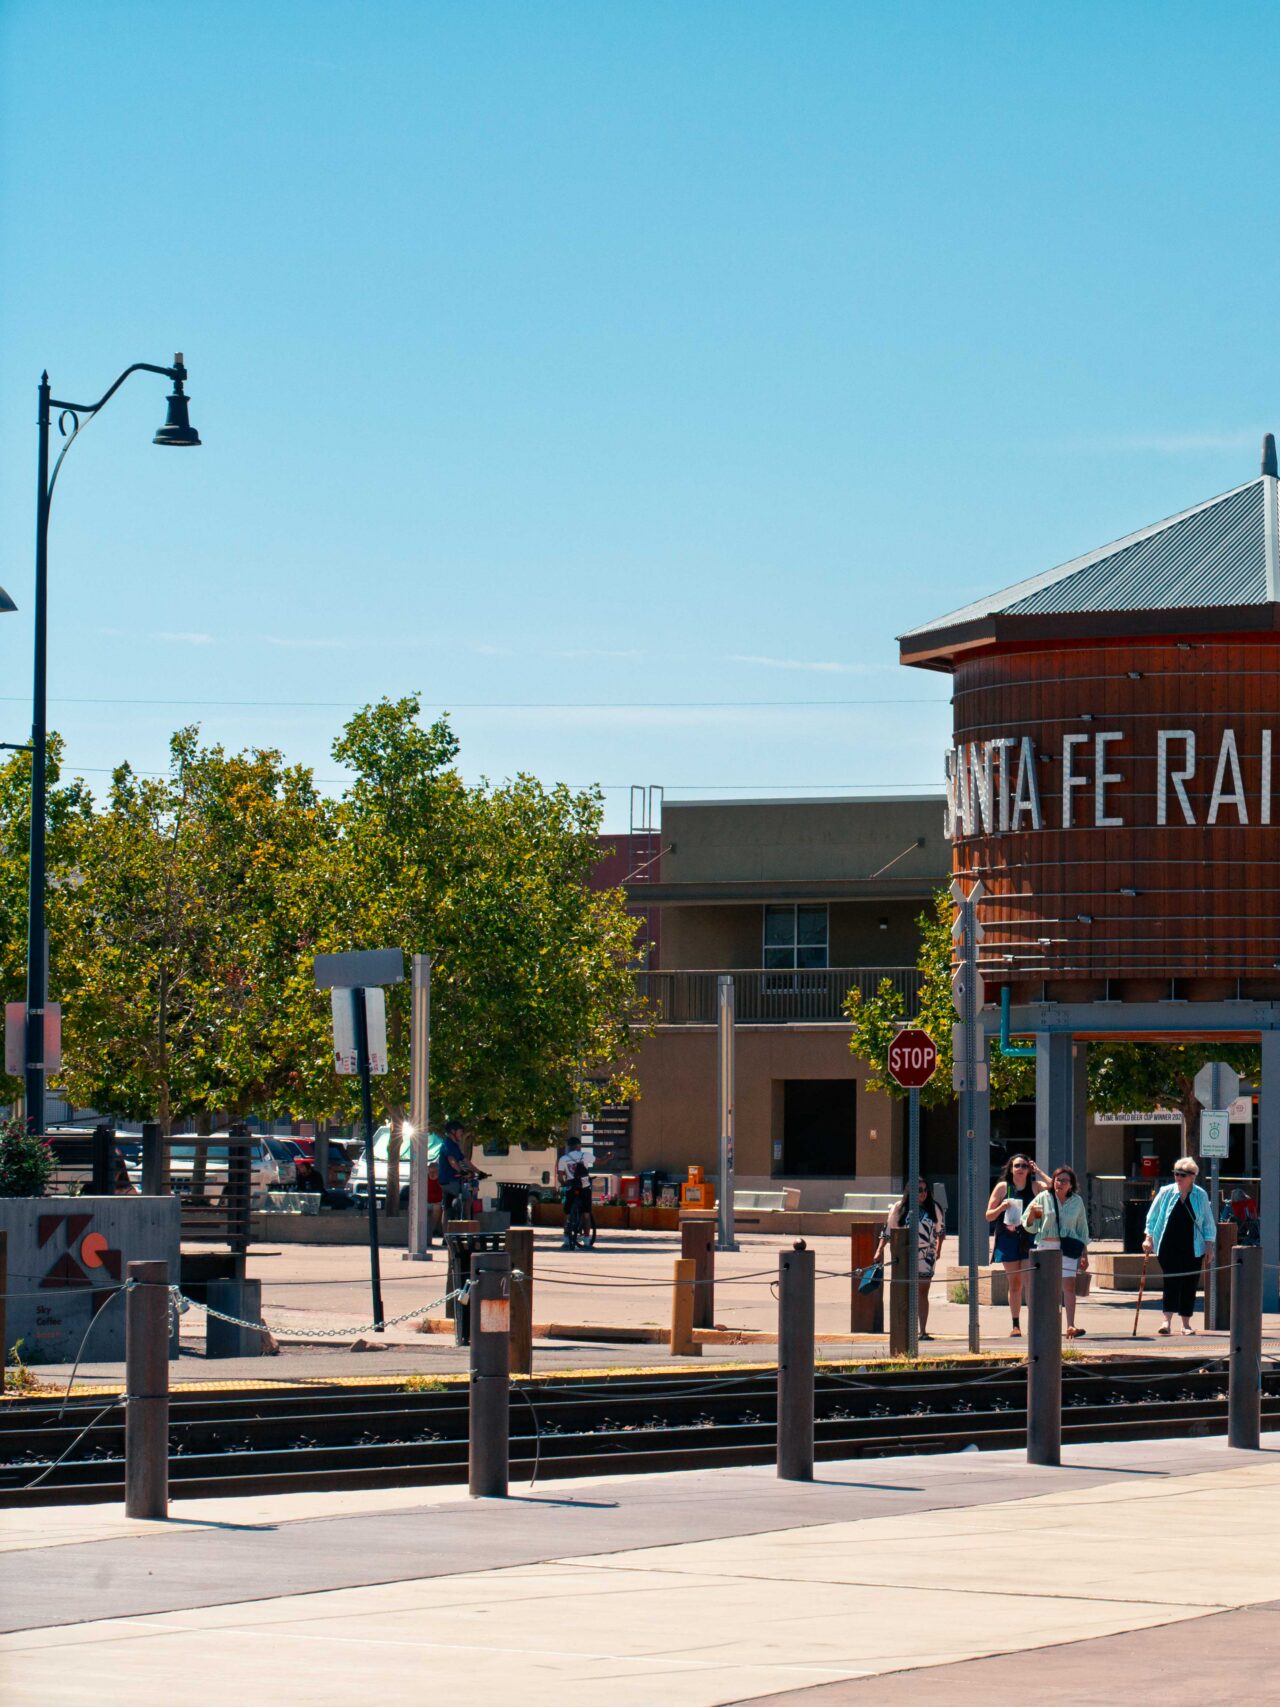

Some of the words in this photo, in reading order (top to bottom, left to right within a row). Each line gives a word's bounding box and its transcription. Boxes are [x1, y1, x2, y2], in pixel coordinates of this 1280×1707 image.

[943, 736, 1041, 840] SANTA
[1062, 731, 1124, 828] FE
[891, 1047, 934, 1070] STOP
[1115, 1114, 1130, 1122] WORLD
[1154, 1113, 1172, 1121] WINNER
[36, 1305, 52, 1315] Sky
[36, 1317, 63, 1326] Coffee
